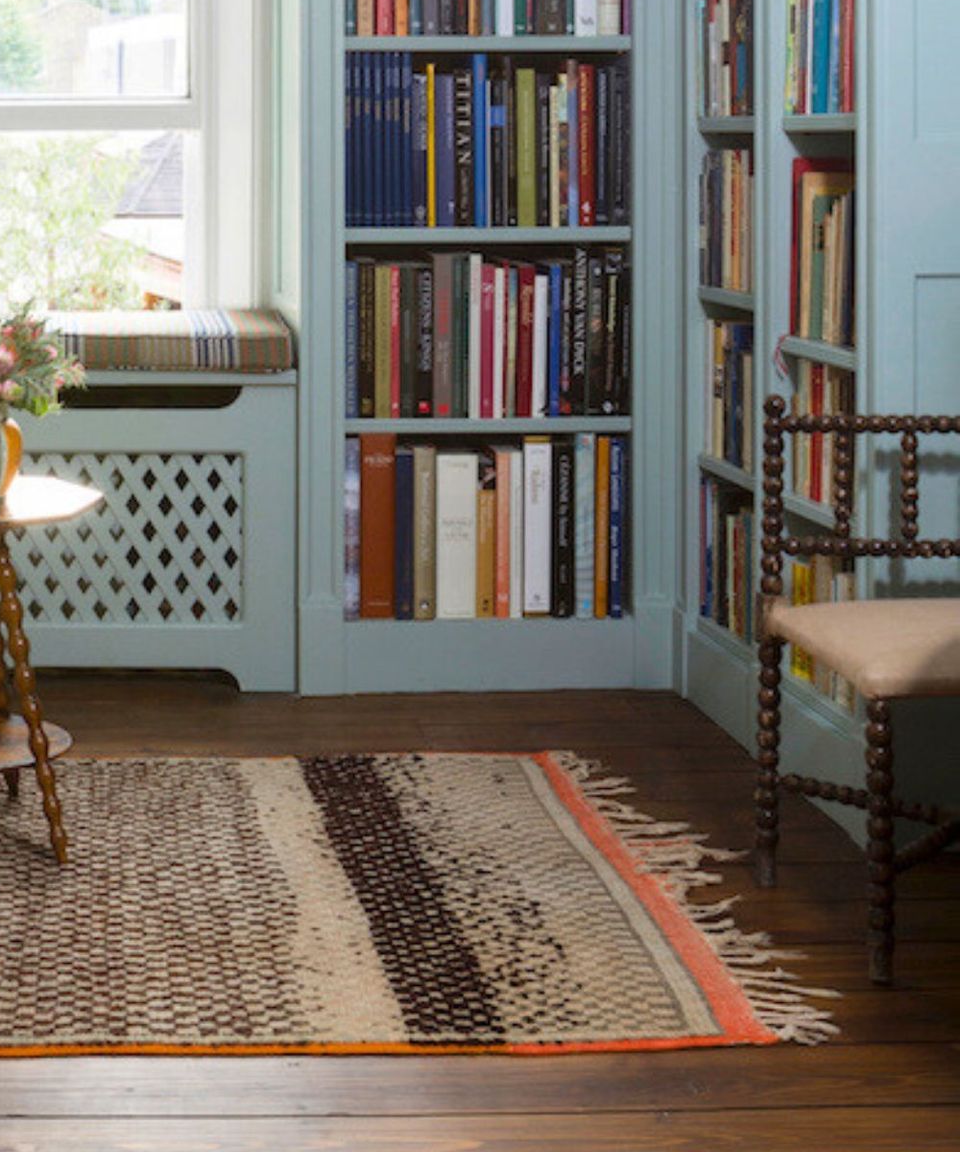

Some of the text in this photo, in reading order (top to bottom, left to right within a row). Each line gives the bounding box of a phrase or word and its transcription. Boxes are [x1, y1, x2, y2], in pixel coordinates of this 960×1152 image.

[456, 73, 472, 164] TITIAN
[573, 248, 587, 375] ANTHONY VAN DYCK
